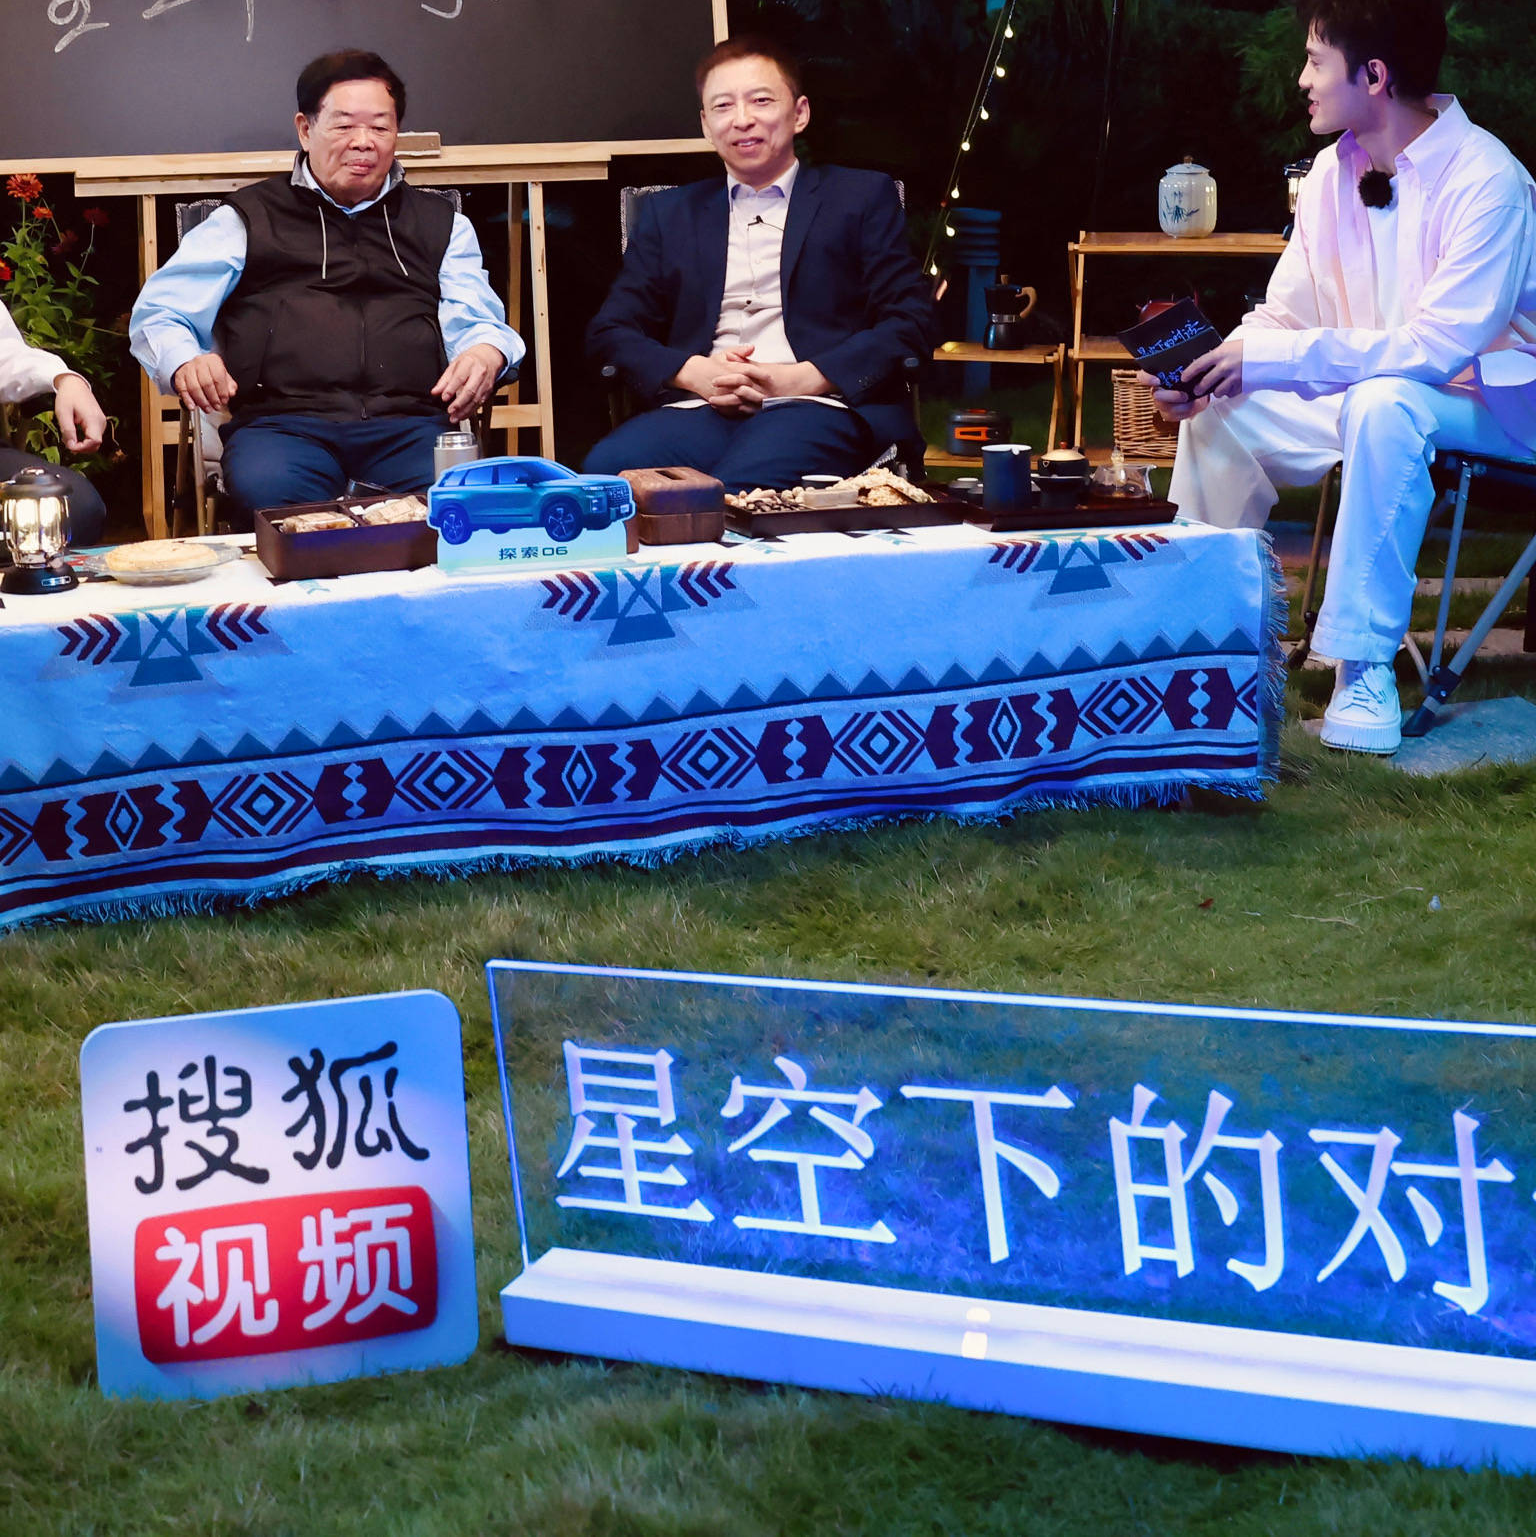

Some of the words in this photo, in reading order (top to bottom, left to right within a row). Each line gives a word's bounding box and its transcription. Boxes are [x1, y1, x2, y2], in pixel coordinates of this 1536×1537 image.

[498, 545, 568, 561] 探索06
[123, 1041, 430, 1195] 搜狐
[156, 1203, 419, 1347] 视频
